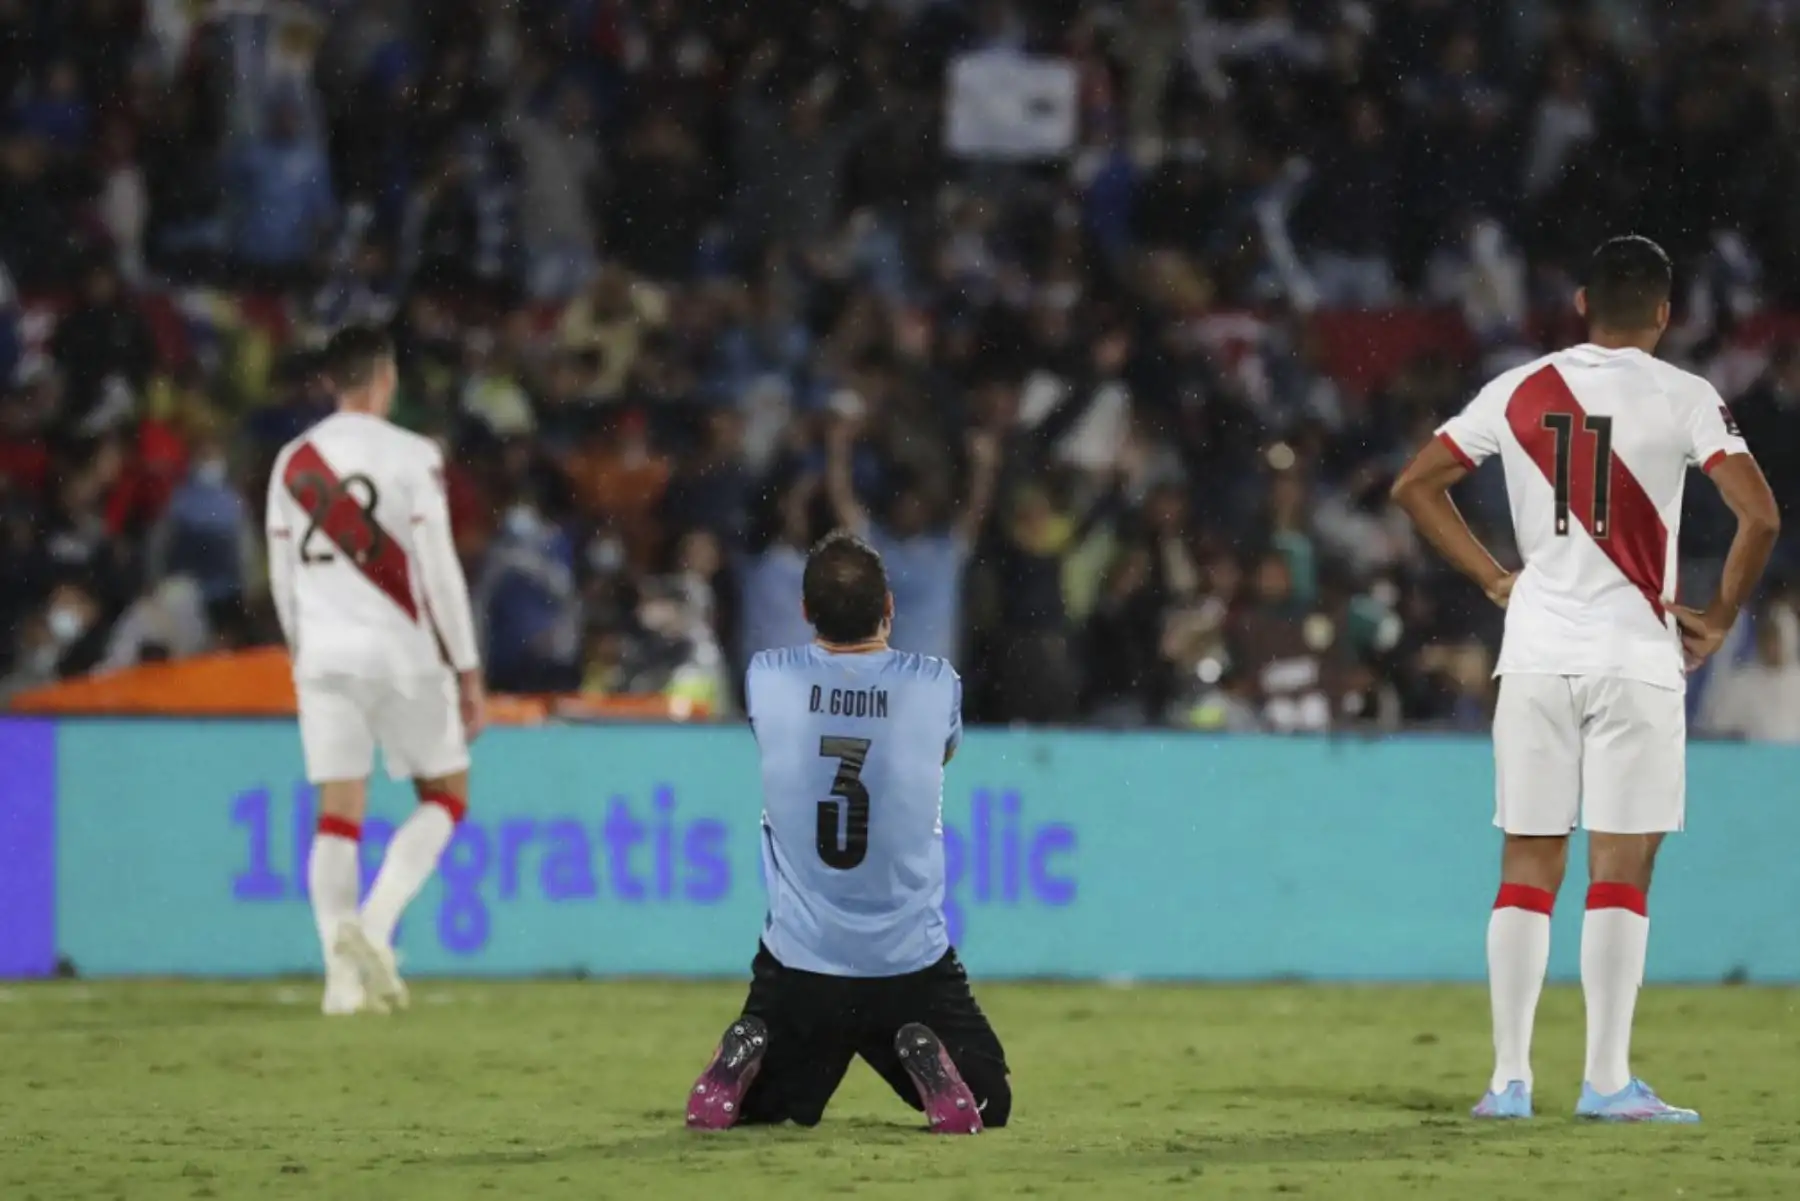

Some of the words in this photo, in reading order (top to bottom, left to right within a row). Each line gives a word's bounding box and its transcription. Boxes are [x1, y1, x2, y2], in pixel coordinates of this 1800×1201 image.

[290, 471, 381, 564] 23
[1541, 412, 1613, 540] 11
[809, 684, 824, 713] D.
[830, 684, 888, 718] GODÍN
[816, 735, 872, 870] 3
[436, 784, 733, 955] gratis
